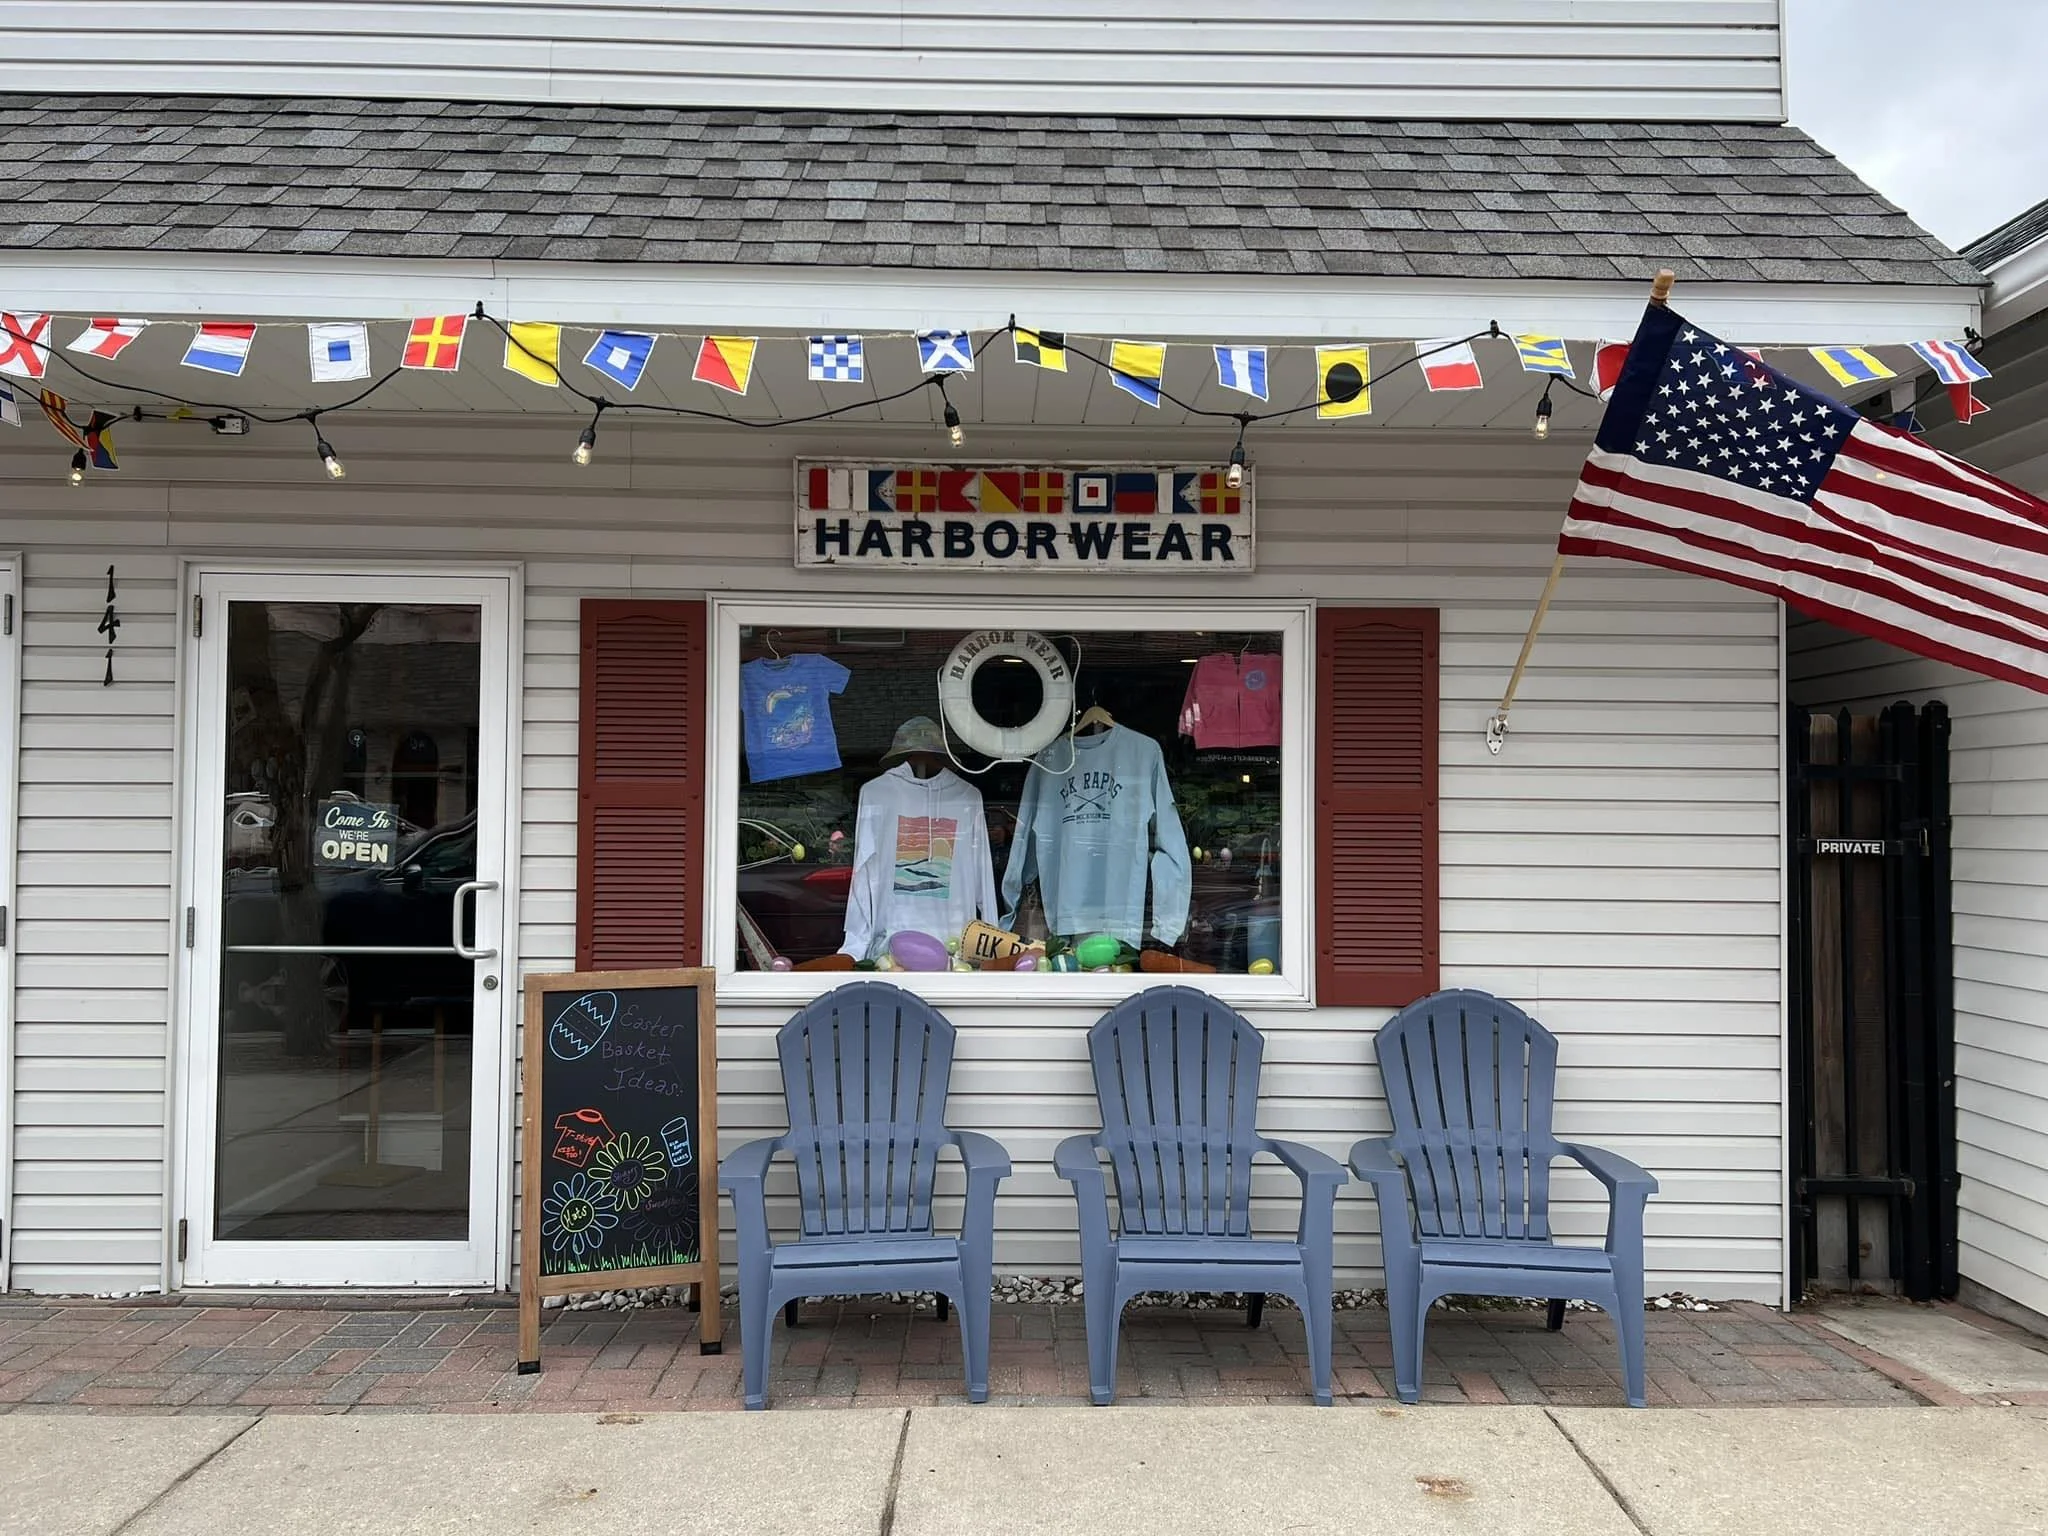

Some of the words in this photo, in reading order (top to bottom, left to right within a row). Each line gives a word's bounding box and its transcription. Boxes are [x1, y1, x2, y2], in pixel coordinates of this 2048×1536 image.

[97, 564, 120, 687] 141
[950, 631, 1015, 681] HARBOR
[1024, 633, 1064, 681] WEAR
[324, 806, 365, 829] Come
[367, 810, 391, 829] In
[339, 829, 369, 841] WE'RE
[321, 840, 389, 864] OPEN
[1821, 842, 1881, 854] PRIVATE
[975, 933, 1004, 959] ELK
[620, 1004, 685, 1038] Easter
[602, 1040, 672, 1066] Basket
[563, 1205, 587, 1228] Hats
